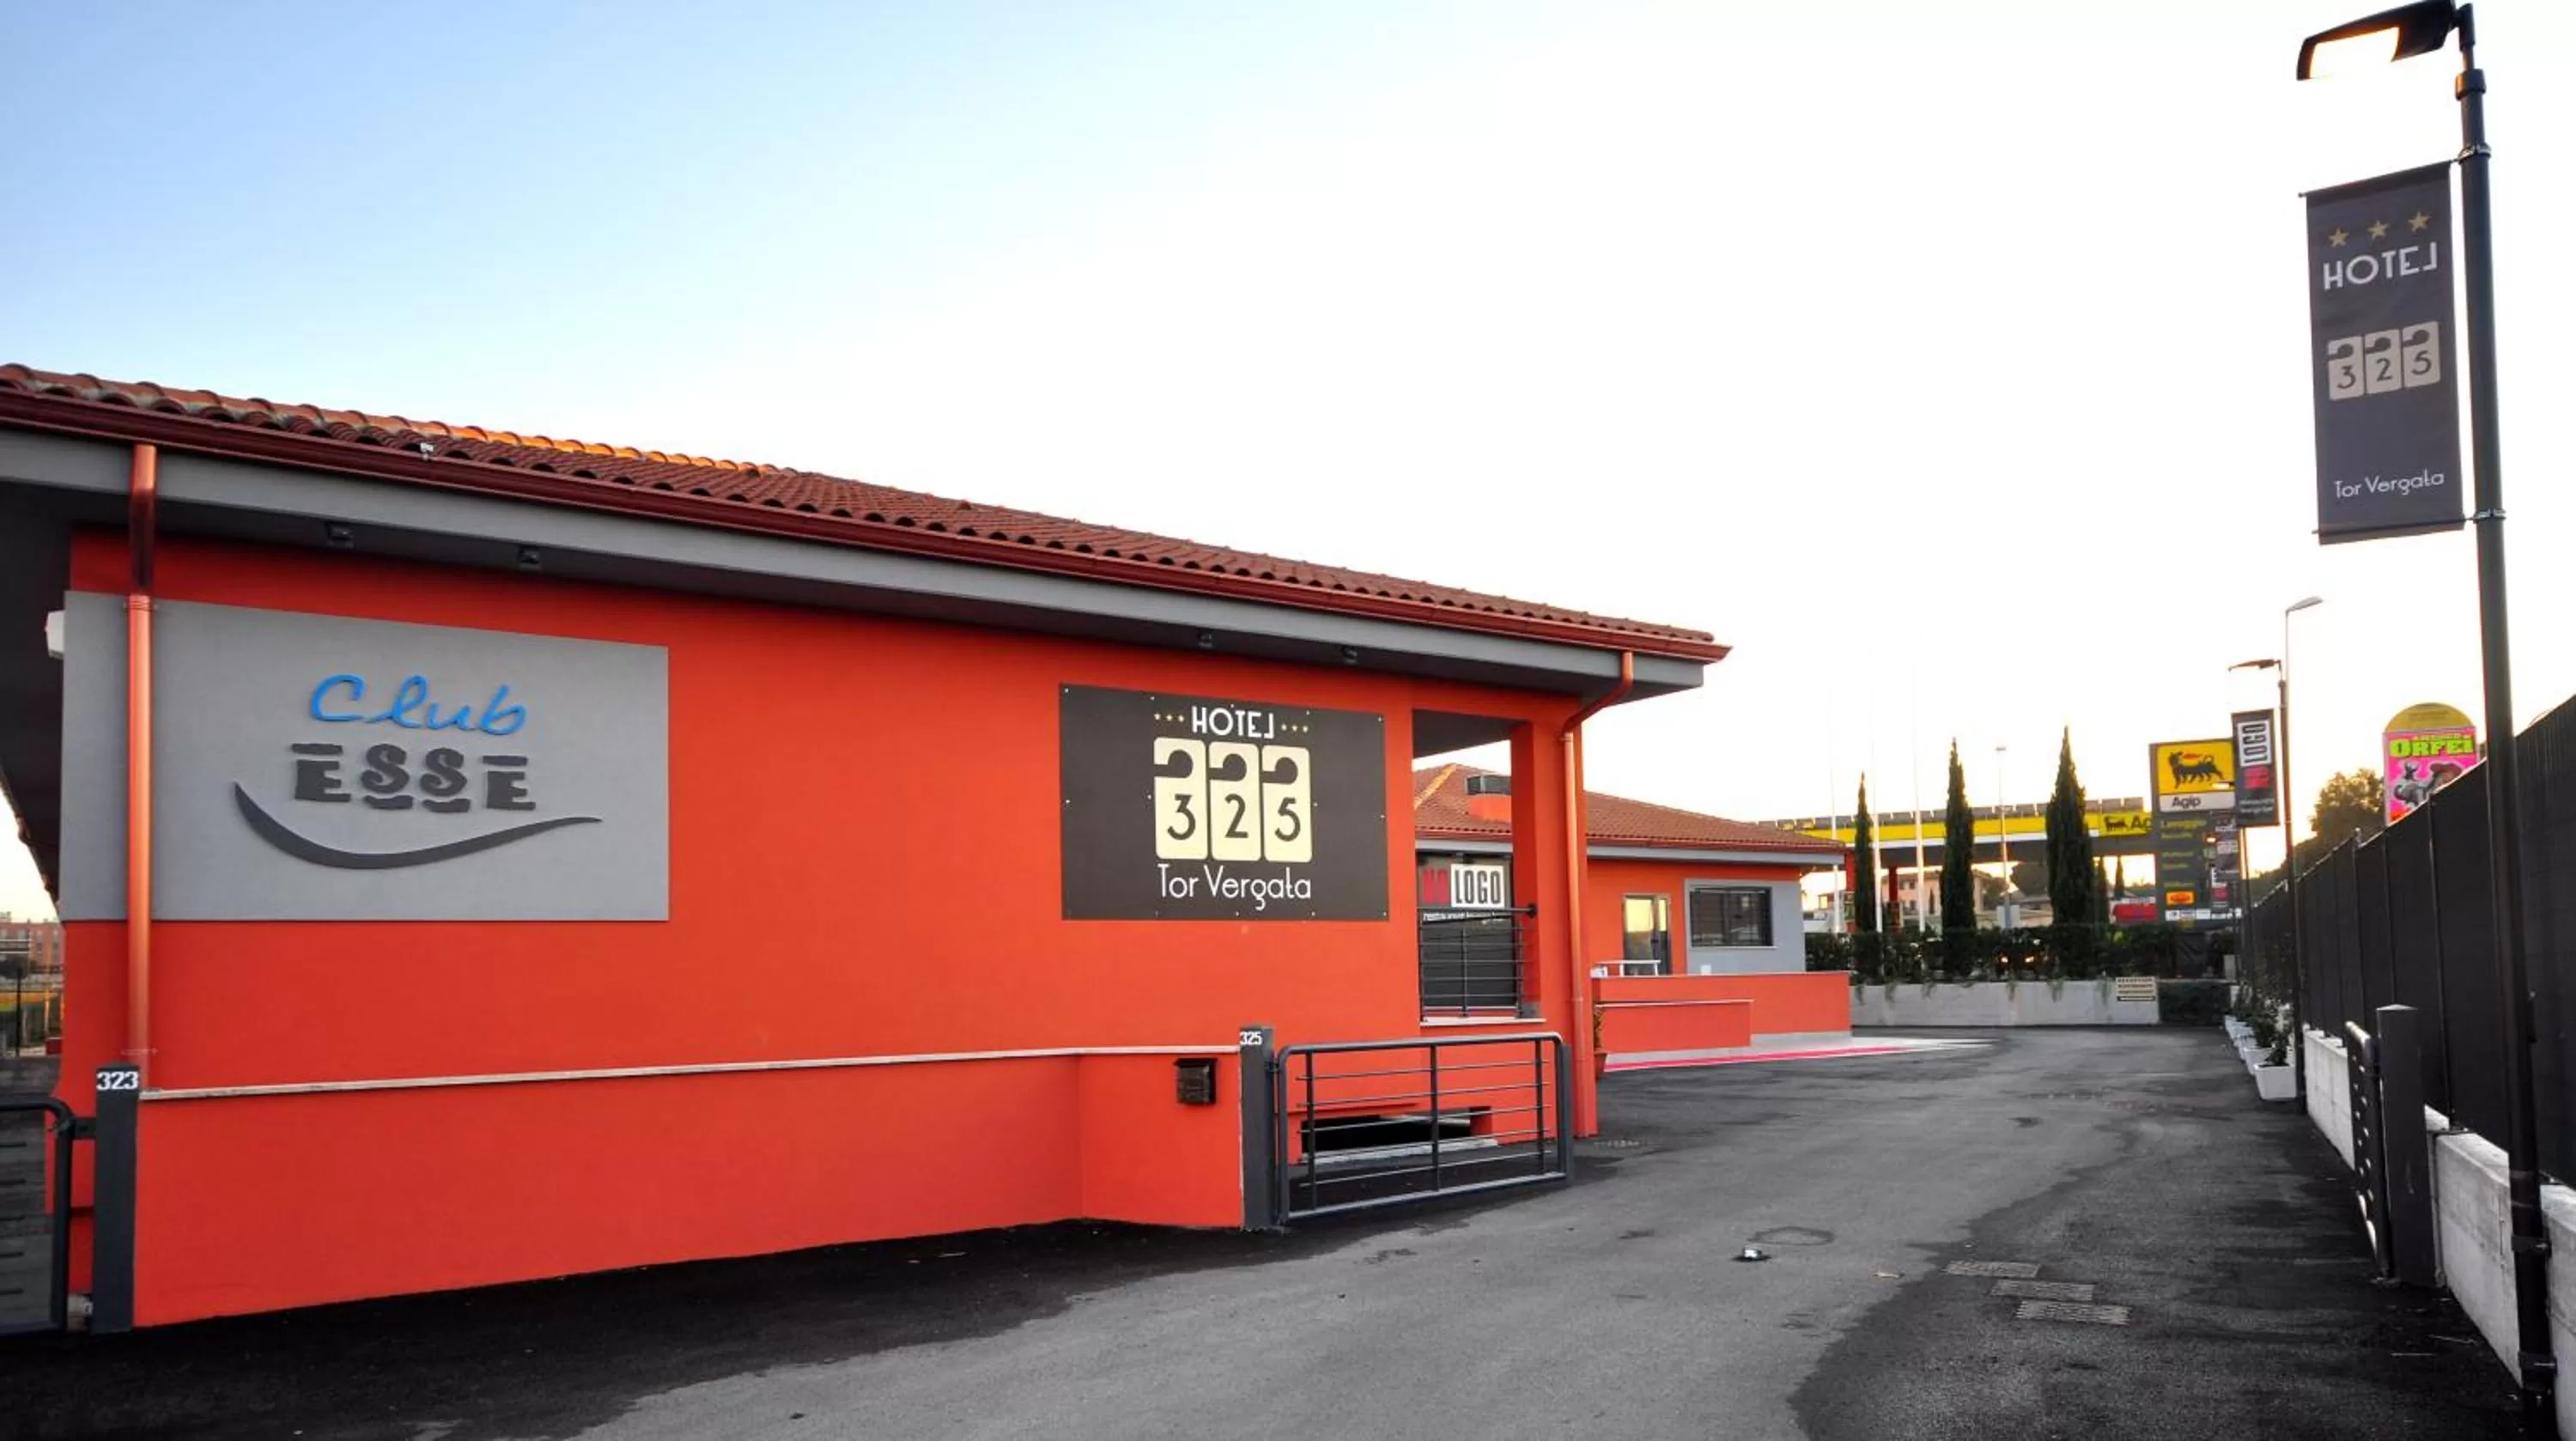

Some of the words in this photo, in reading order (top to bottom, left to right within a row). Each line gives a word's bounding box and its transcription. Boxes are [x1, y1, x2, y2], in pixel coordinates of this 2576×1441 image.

[2323, 241, 2437, 290] HOTEL
[2337, 350, 2432, 389] 325
[2334, 480, 2362, 499] Tor
[2364, 467, 2445, 496] Vergata
[308, 673, 527, 736] Club
[1192, 706, 1274, 739] HOTEL
[2242, 723, 2268, 763] LOGO
[2390, 738, 2474, 757] ORFEI
[290, 743, 537, 814] ESSE
[1167, 793, 1301, 842] 325
[2172, 796, 2202, 809] Agip
[1157, 863, 1200, 898] Tor
[1204, 864, 1311, 910] Vergata
[1454, 869, 1502, 905] LOGO
[1239, 1031, 1263, 1046] 325
[96, 1071, 139, 1091] 323
